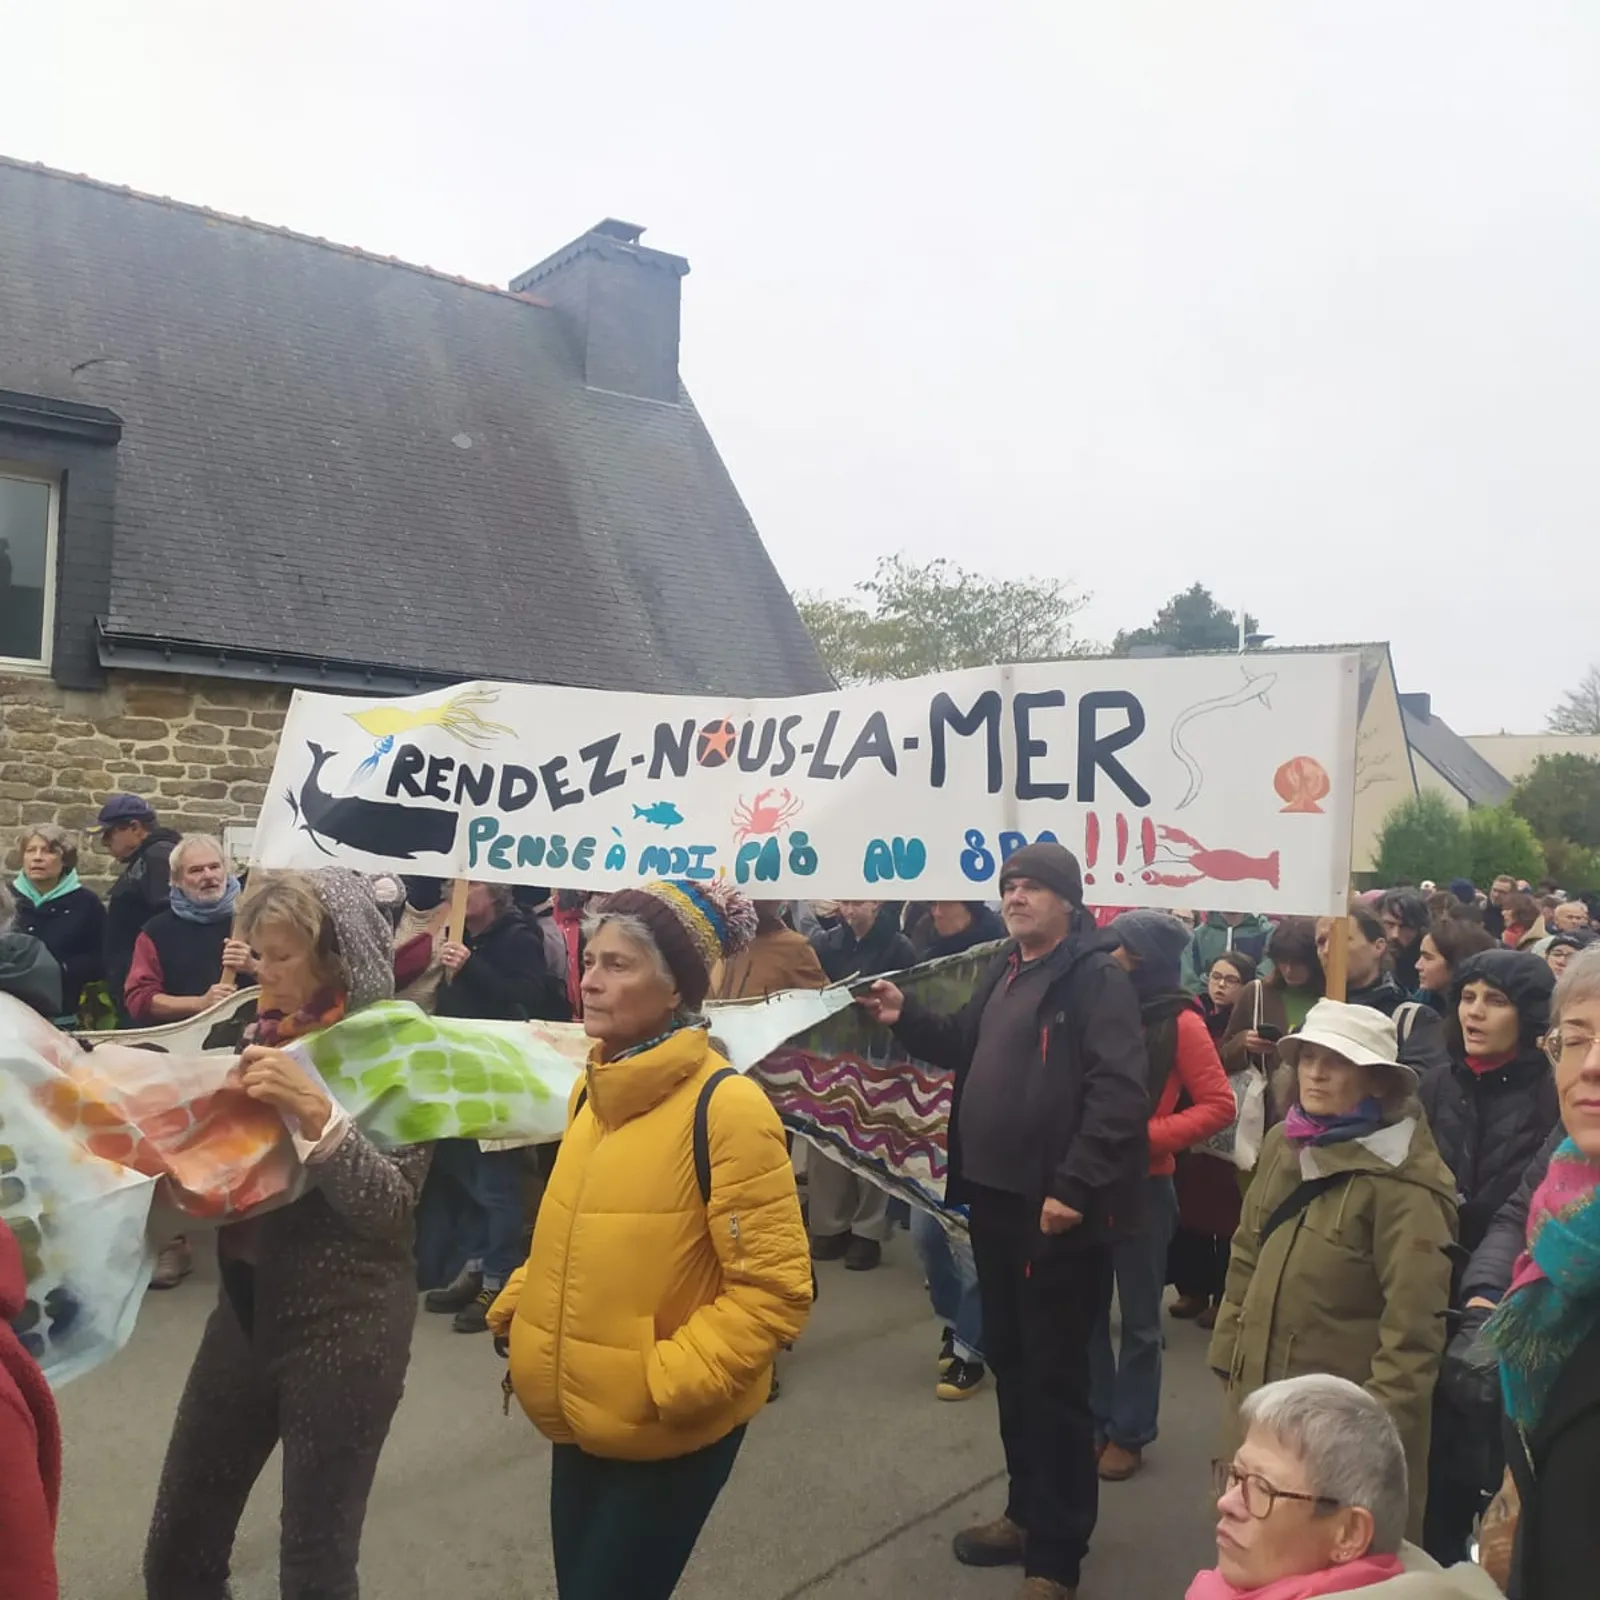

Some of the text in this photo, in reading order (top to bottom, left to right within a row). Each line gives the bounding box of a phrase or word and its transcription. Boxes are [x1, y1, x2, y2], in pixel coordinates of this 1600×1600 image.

[469, 816, 597, 871] PENSE
[604, 826, 626, 871] À
[735, 830, 818, 884] PAS
[864, 836, 926, 883] AU
